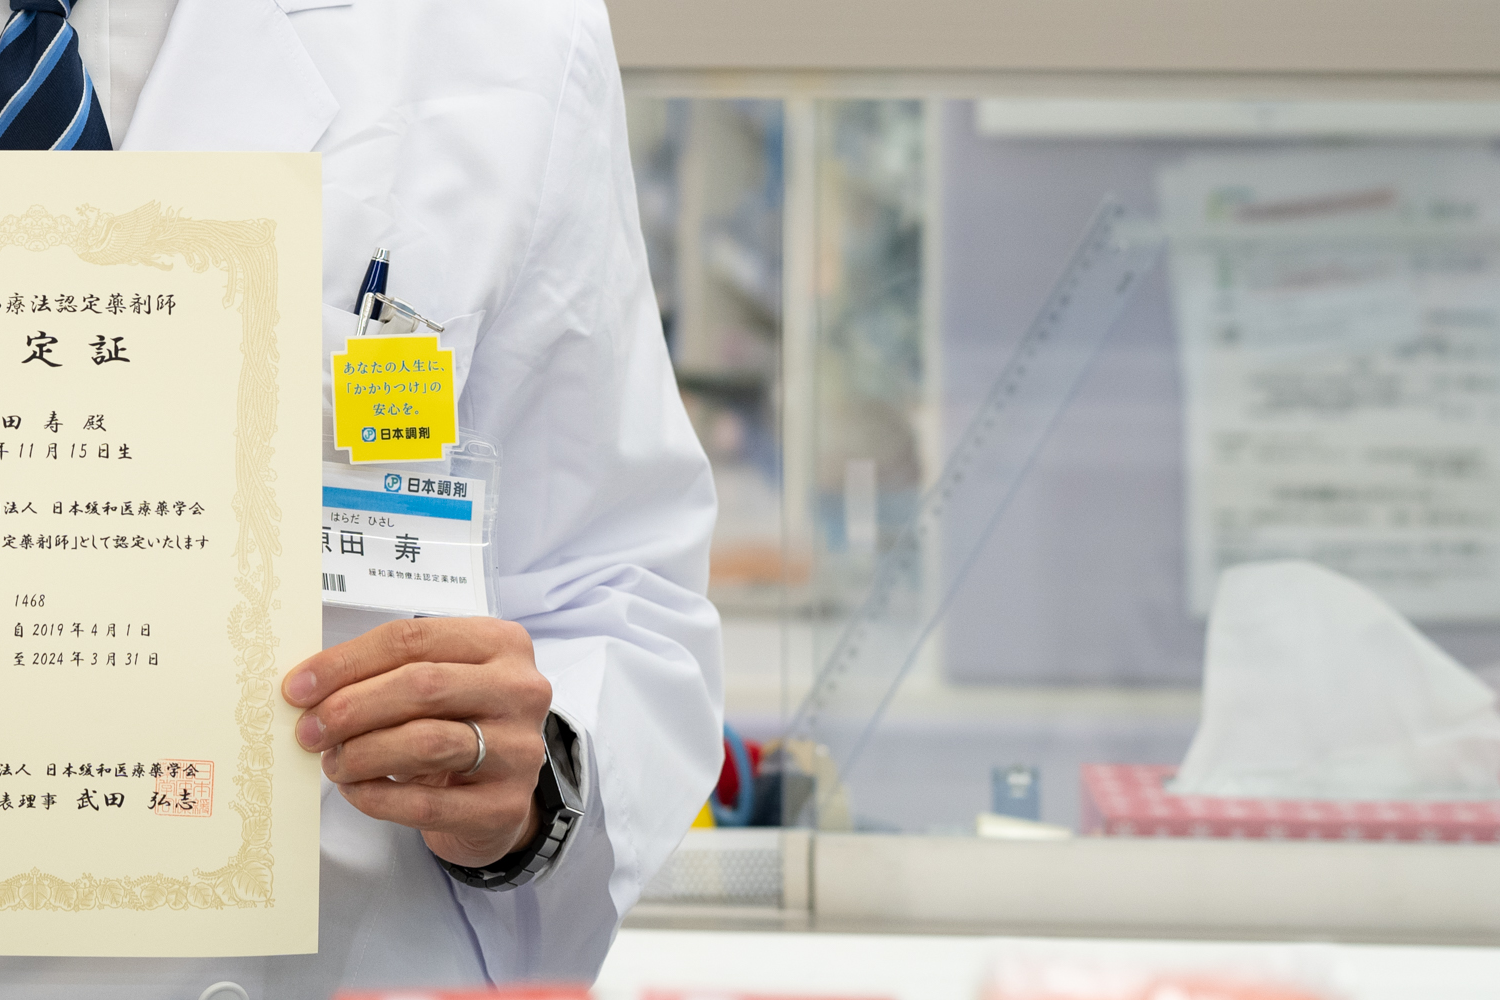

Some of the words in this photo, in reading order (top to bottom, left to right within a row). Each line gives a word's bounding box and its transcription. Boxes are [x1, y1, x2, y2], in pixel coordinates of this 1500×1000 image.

[343, 359, 446, 375] あなたの人生に、
[346, 381, 442, 396] 「かかりつけ」の
[372, 402, 420, 417] 安心を。
[44, 410, 64, 434] 寿
[82, 413, 108, 433] 殿
[380, 426, 431, 441] 日本調剤
[407, 476, 468, 498] 日本調剤
[52, 499, 206, 517] 日本緩和医療薬学会
[330, 511, 361, 525] はらだ
[368, 515, 396, 528] ひさし
[394, 532, 422, 564] 寿
[368, 567, 468, 585] 緩和薬物療法認定薬剤師
[14, 593, 46, 608] 1468
[46, 761, 200, 779] 日本緩和医療薬学会
[76, 787, 126, 812] 武田
